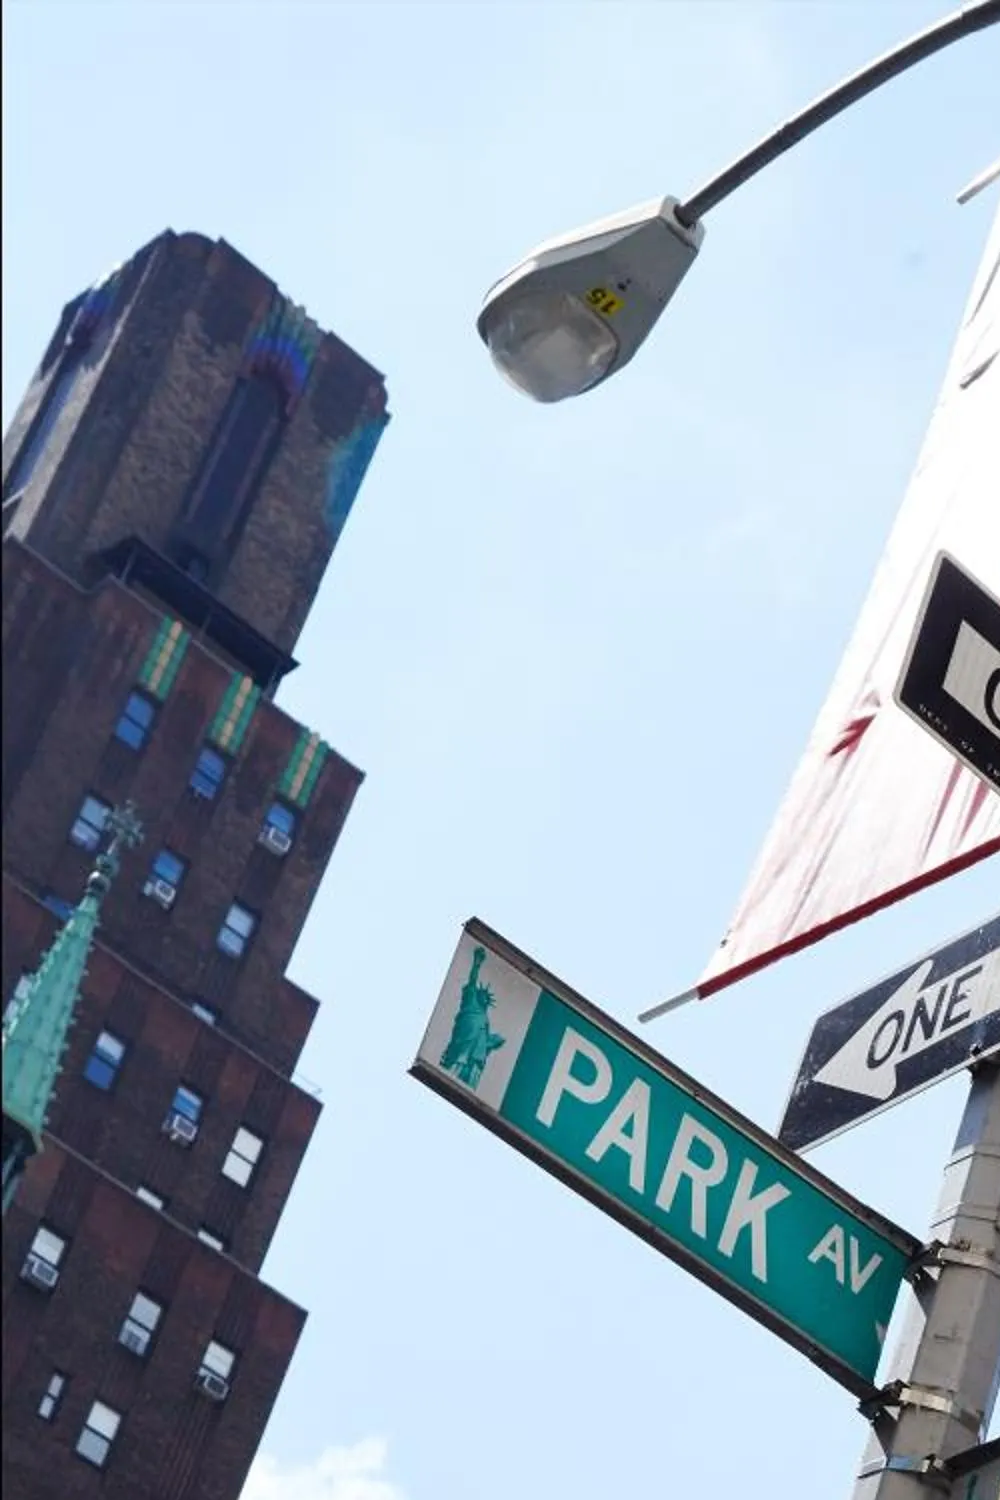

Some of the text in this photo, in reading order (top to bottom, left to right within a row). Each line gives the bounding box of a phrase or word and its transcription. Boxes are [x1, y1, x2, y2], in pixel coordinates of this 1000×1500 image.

[867, 964, 982, 1069] ONE
[535, 1026, 882, 1295] PARK AV
